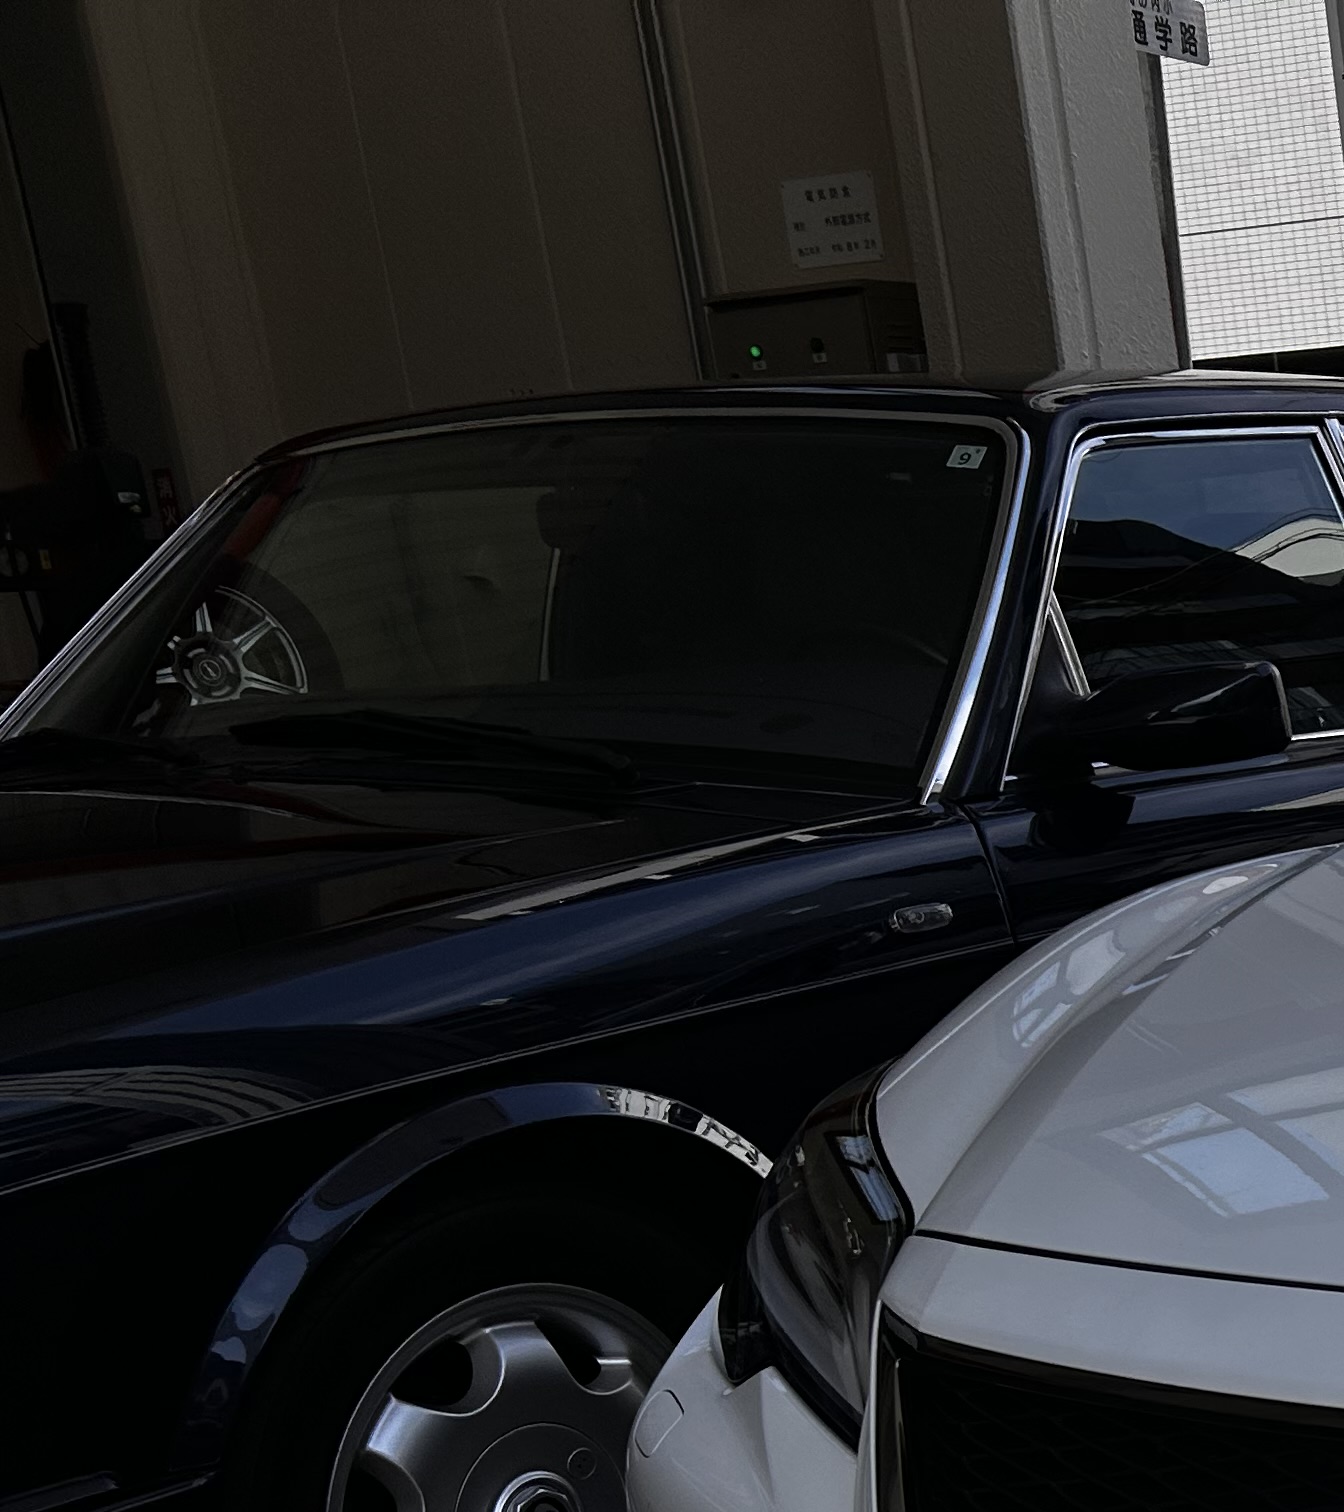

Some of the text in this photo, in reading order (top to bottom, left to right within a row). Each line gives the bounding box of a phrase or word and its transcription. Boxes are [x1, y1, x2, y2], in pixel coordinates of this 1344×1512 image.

[1132, 10, 1198, 57] 通学路
[958, 452, 972, 466] 9
